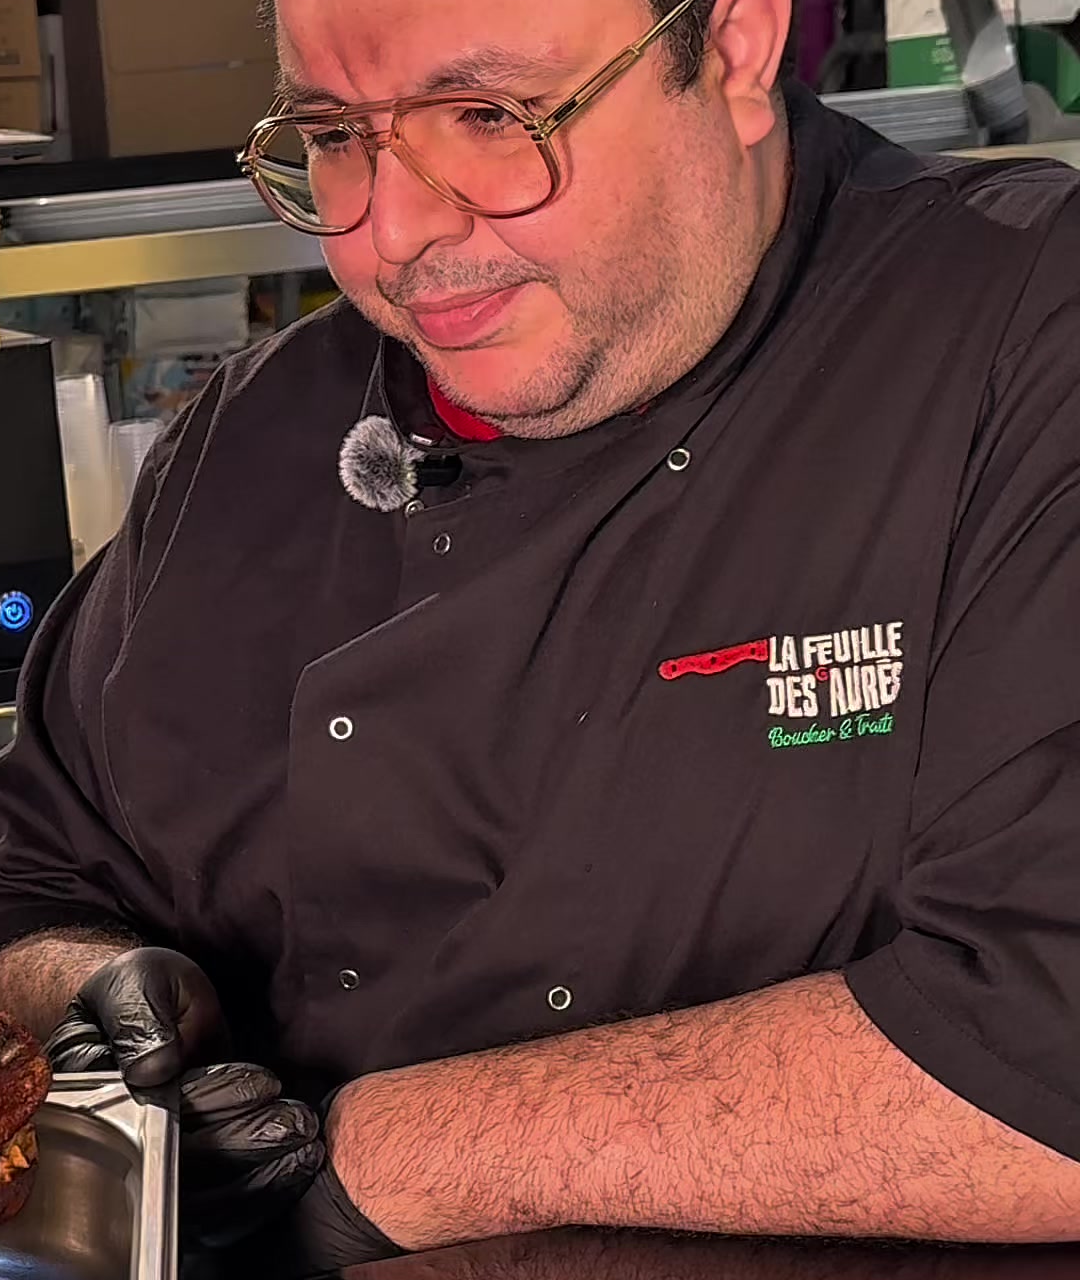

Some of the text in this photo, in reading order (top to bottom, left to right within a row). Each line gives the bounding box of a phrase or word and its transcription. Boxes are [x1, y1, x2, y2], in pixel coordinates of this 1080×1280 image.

[769, 621, 904, 672] LA FEUILLE
[766, 673, 819, 718] DES
[768, 723, 836, 748] Boucher
[839, 718, 854, 739] &
